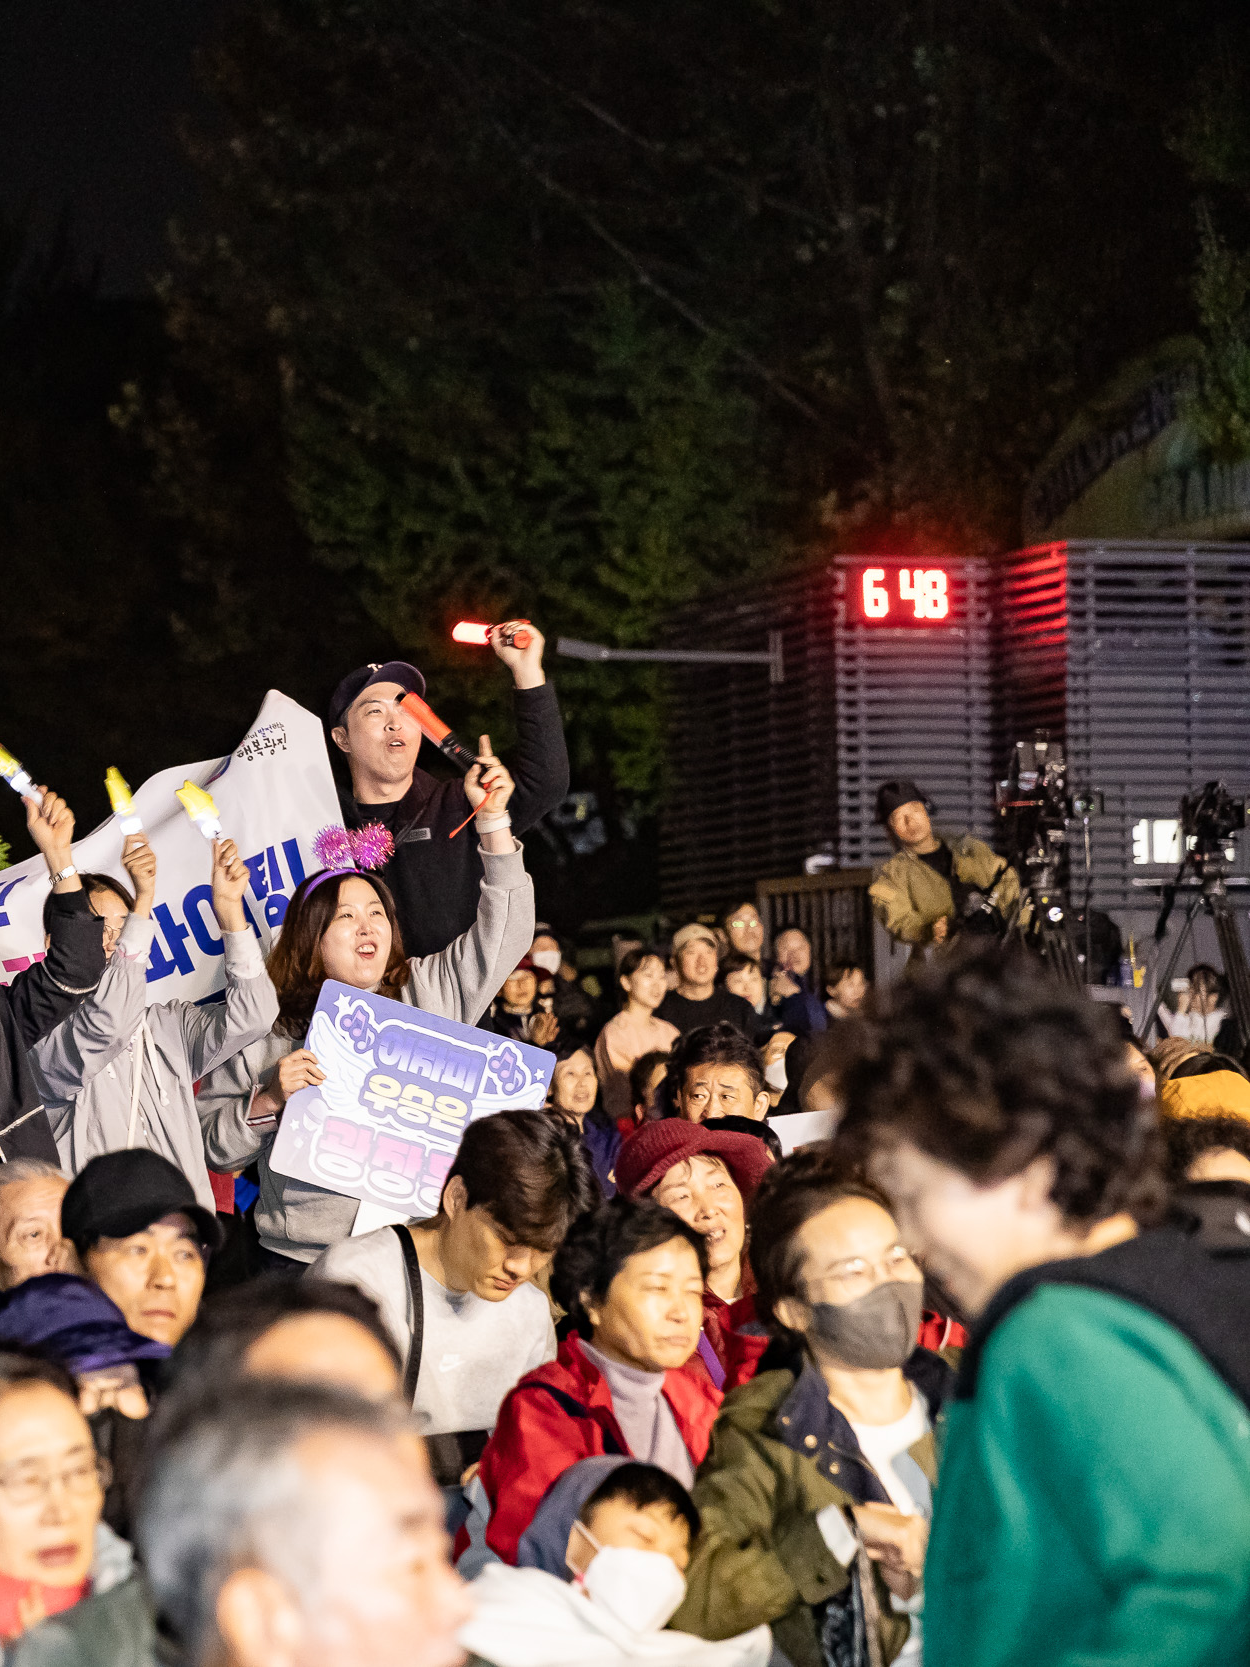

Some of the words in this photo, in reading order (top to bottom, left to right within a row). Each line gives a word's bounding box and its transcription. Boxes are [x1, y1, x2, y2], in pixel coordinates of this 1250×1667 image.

[862, 568, 889, 618] 6
[898, 568, 949, 619] 48
[378, 1031, 482, 1094] 어차피
[363, 1073, 468, 1137] 우승은
